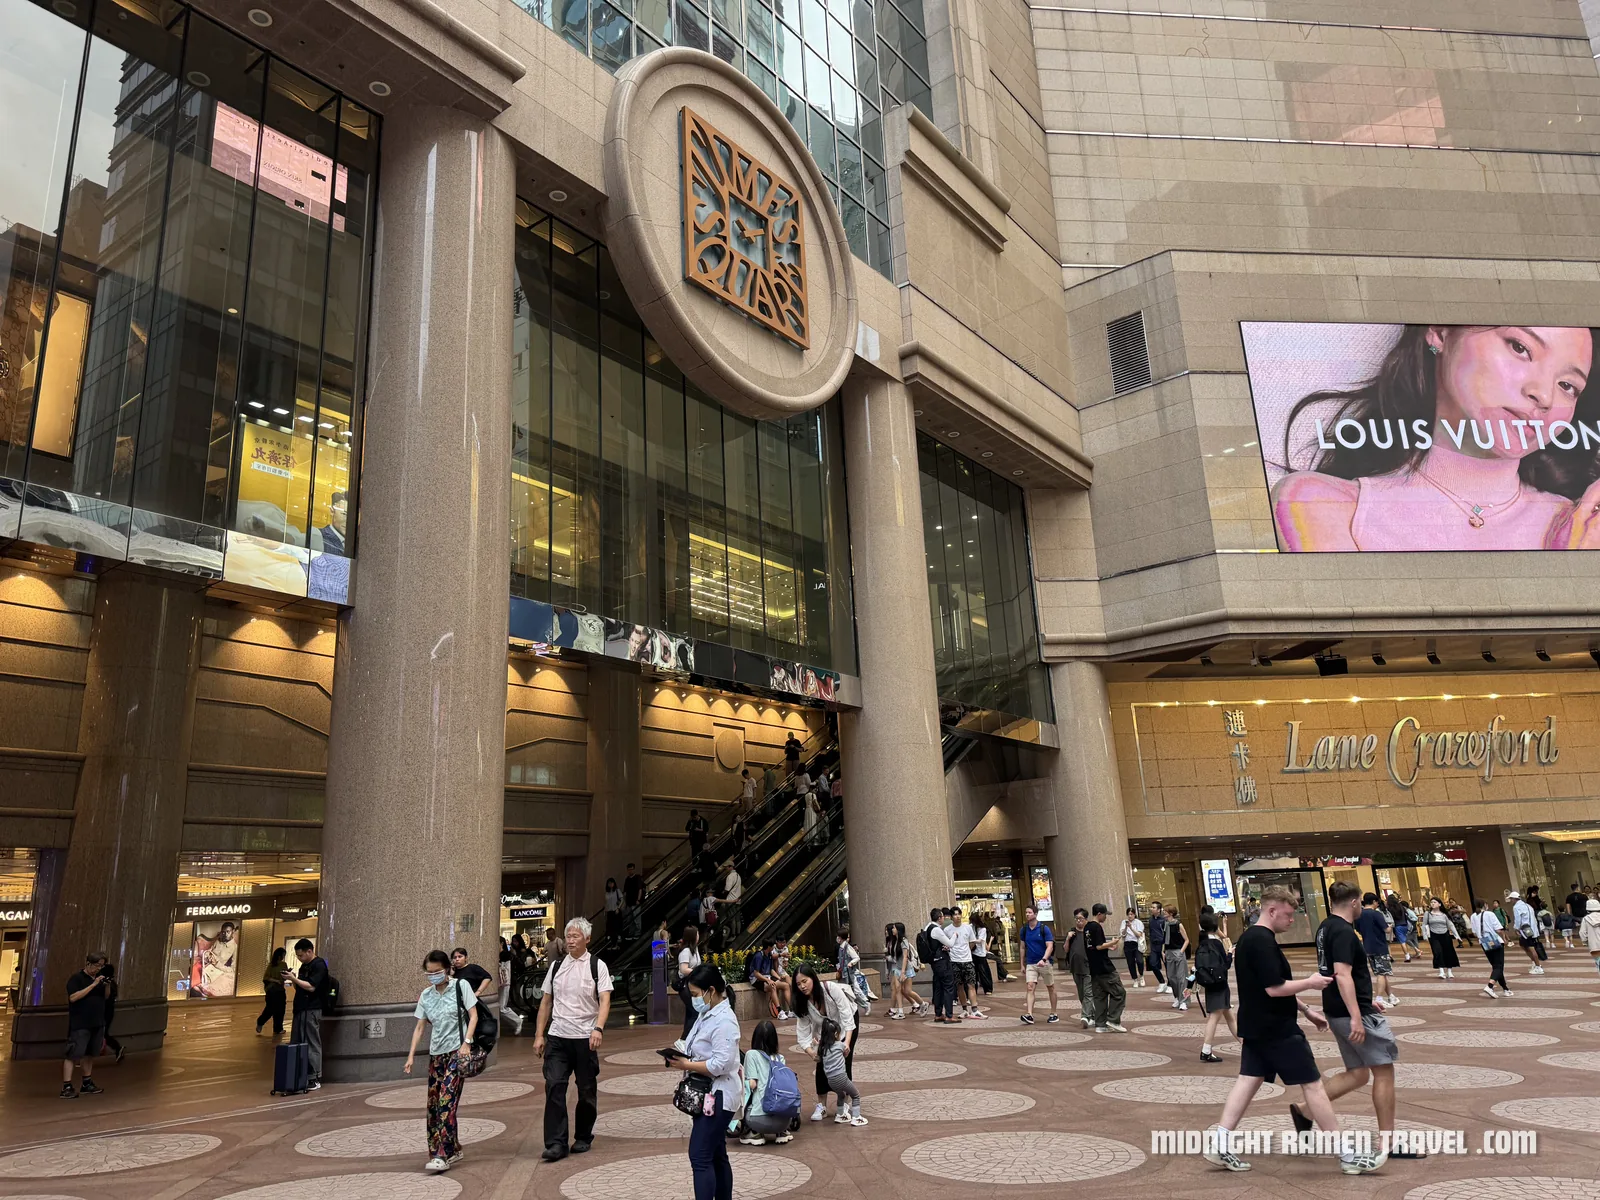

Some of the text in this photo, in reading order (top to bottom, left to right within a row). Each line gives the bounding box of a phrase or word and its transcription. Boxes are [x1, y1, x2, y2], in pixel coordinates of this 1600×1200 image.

[1315, 418, 1600, 450] LOUIS VUITTON
[1224, 709, 1257, 804] 連卡佛
[1281, 714, 1560, 788] Lane Crawford
[186, 904, 252, 916] FERRAGAMO
[514, 909, 544, 917] LANCÔME
